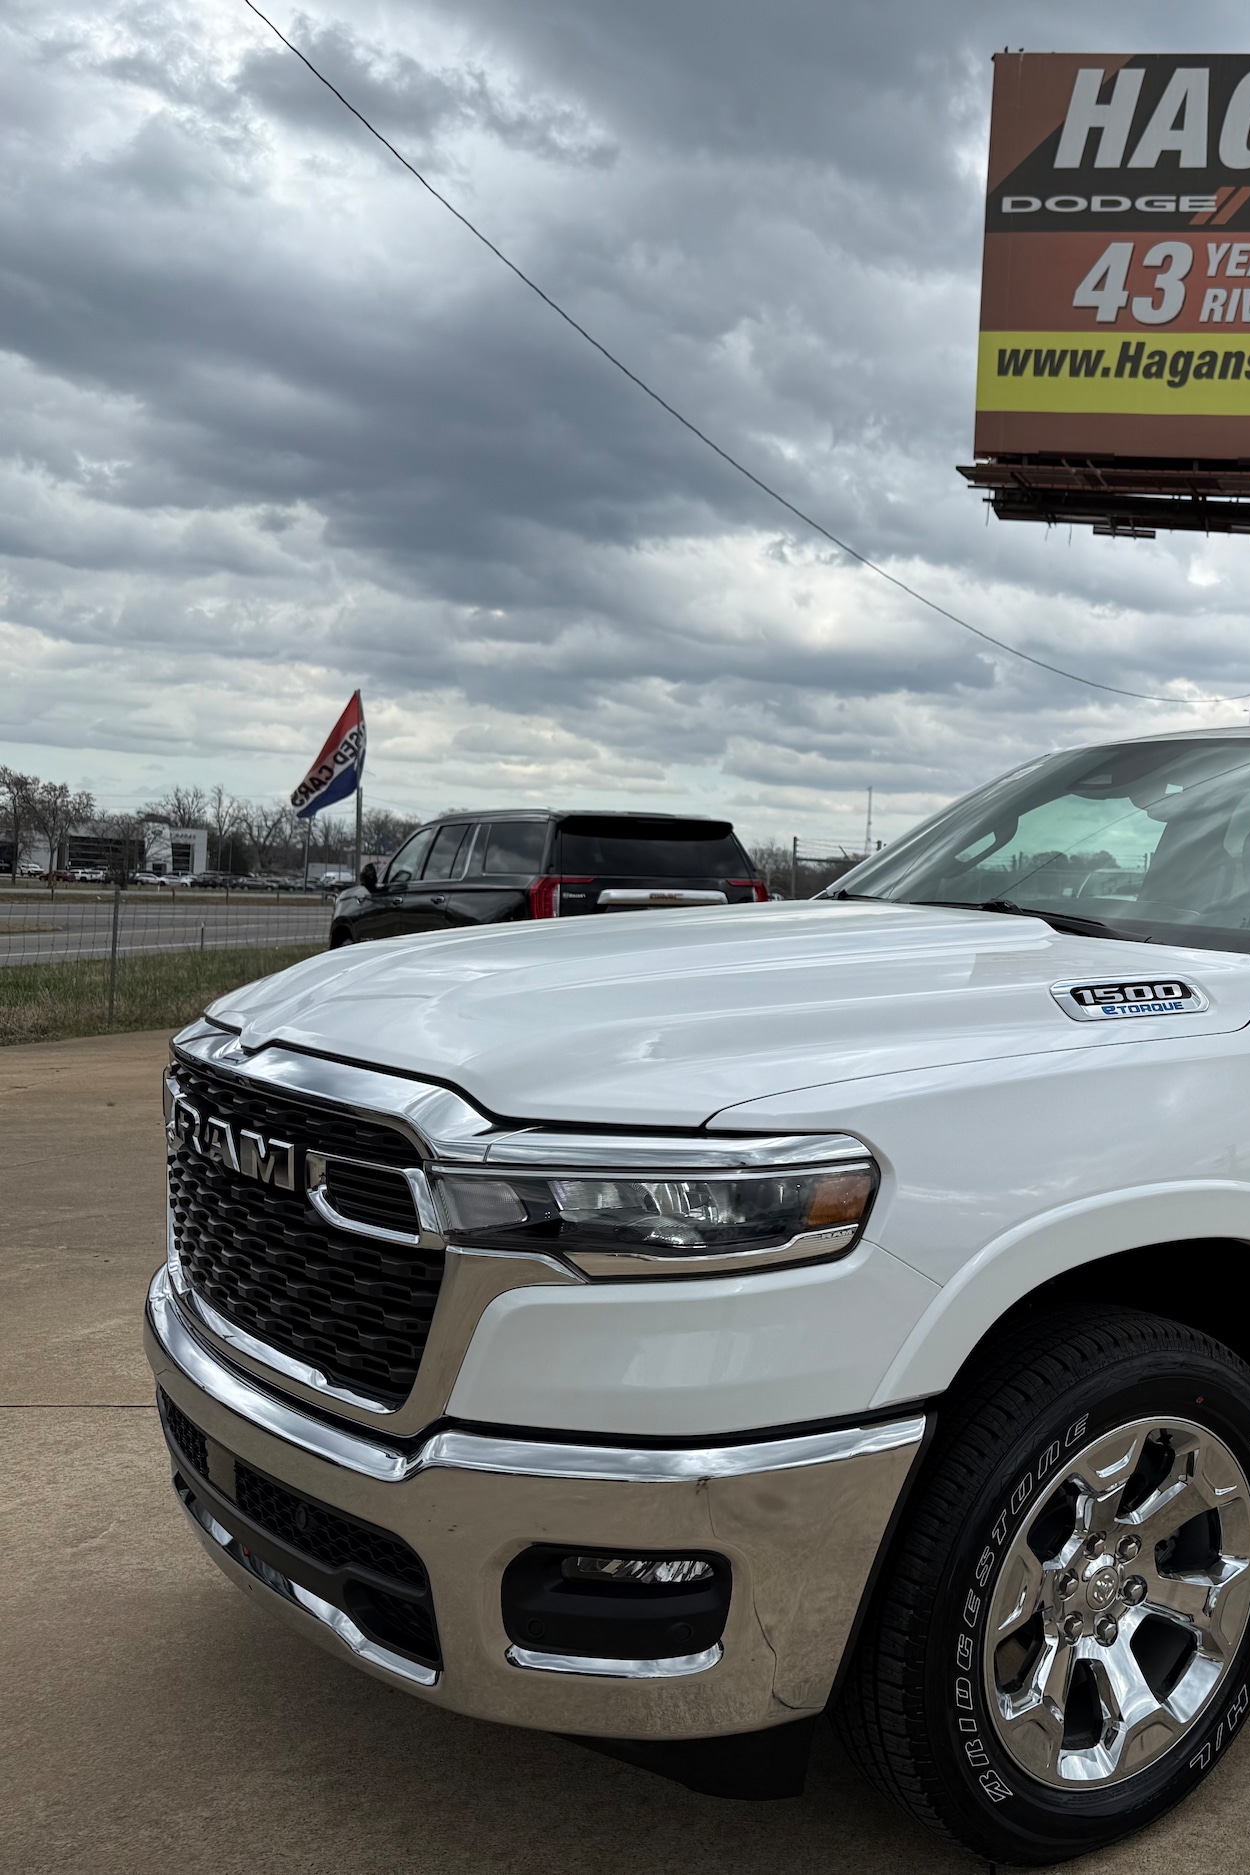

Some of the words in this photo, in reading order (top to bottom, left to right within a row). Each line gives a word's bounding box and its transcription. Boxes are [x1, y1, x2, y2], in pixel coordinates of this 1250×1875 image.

[1001, 195, 1217, 213] DODGE
[1072, 240, 1195, 325] 43
[1075, 983, 1183, 1005] 1500
[175, 1099, 295, 1191] RAM
[956, 1412, 1090, 1803] BRIDGESTONE
